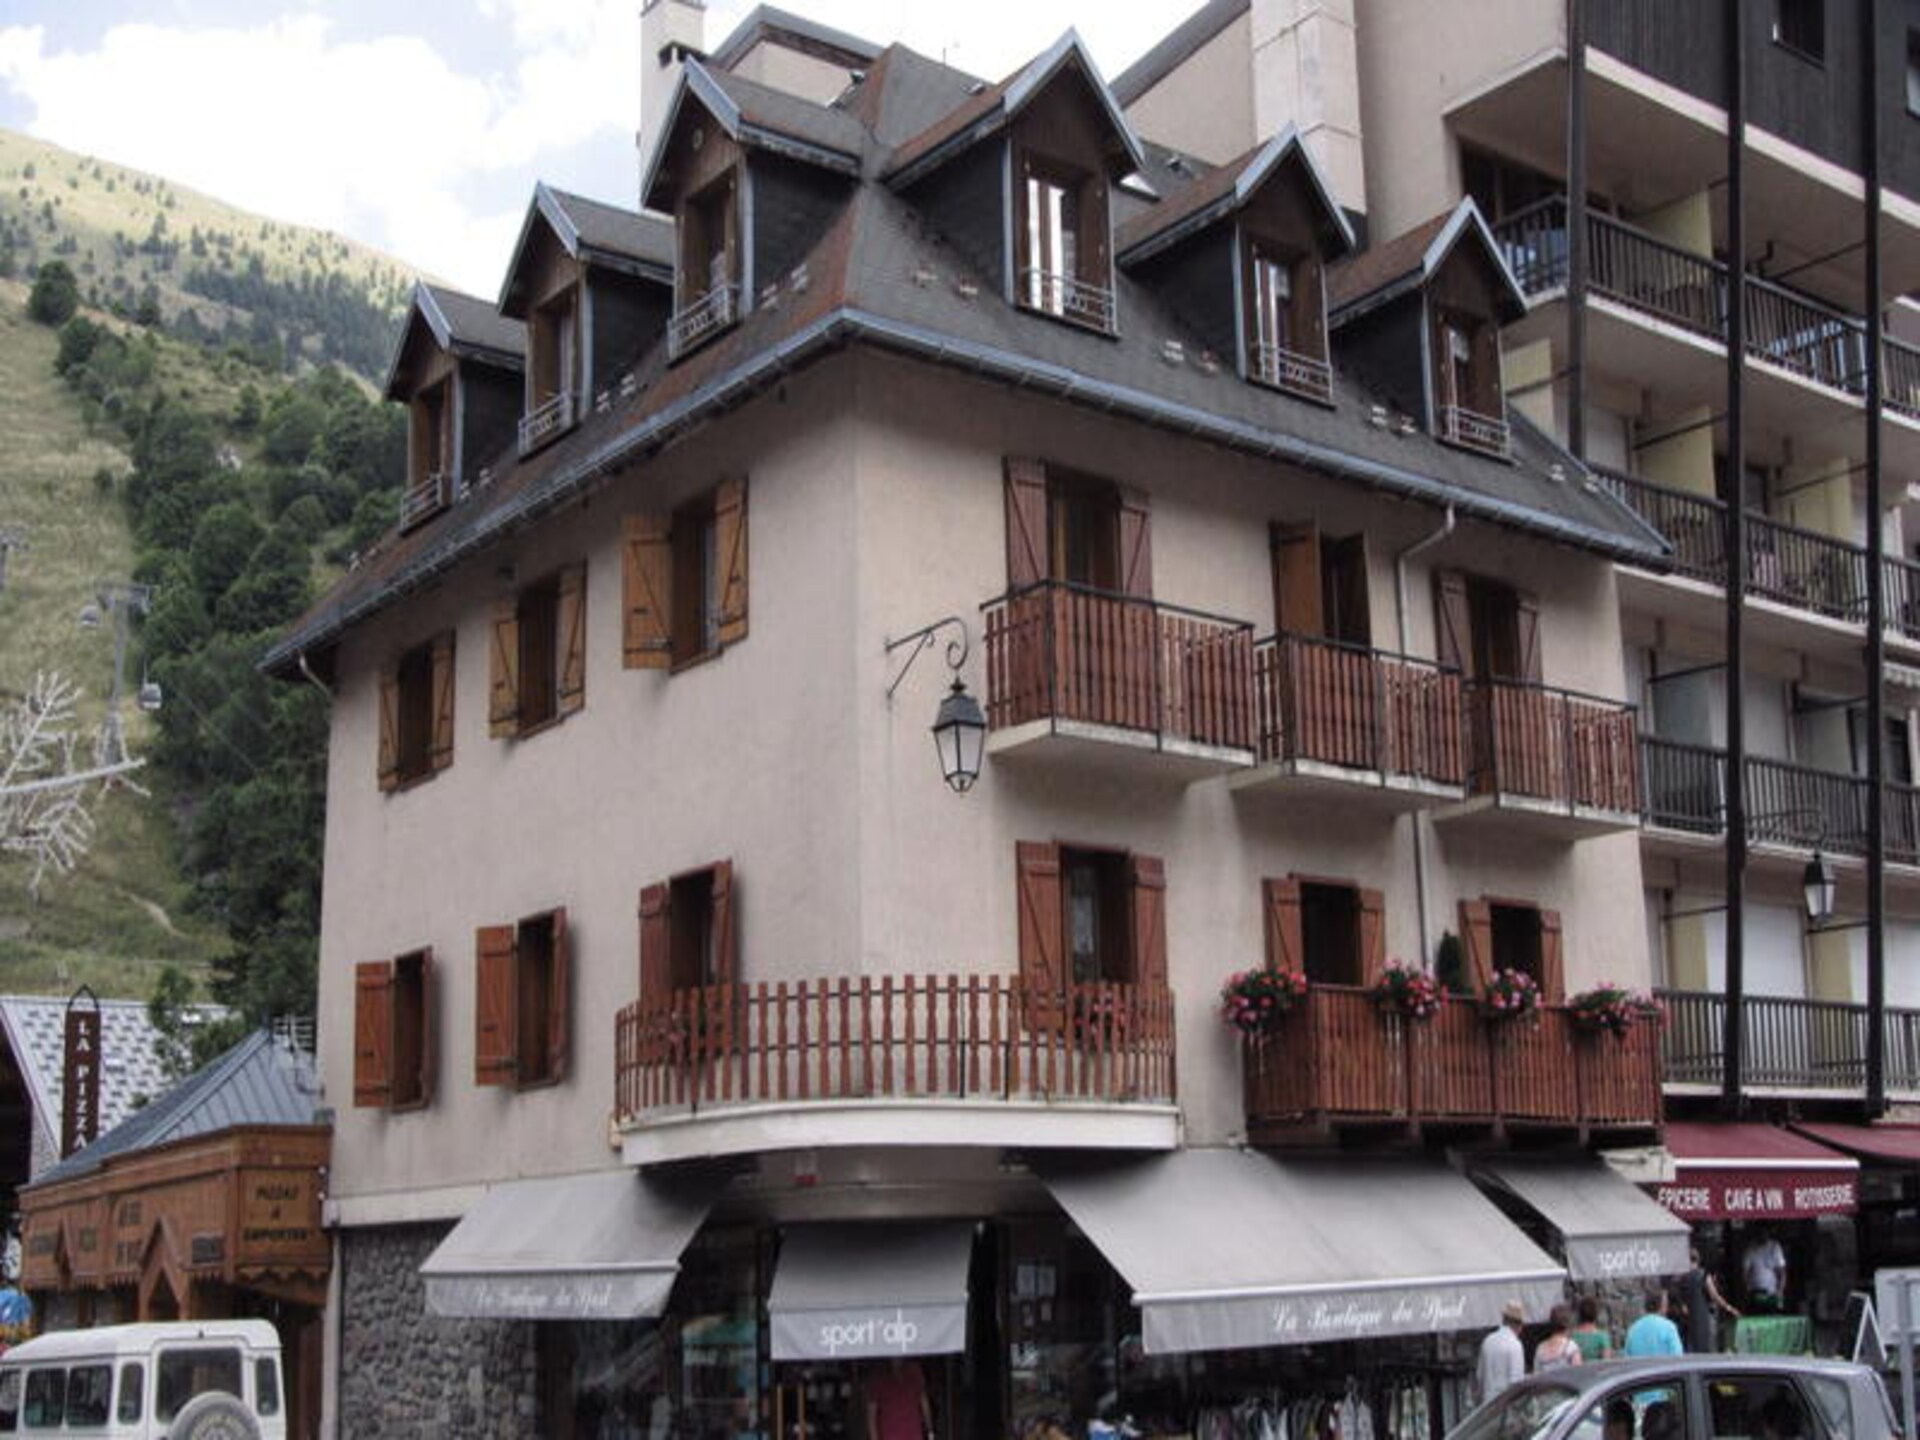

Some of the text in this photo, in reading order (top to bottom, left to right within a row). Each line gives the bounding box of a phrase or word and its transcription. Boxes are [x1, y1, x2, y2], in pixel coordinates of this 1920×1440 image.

[73, 1021, 91, 1149] LA PIZZA
[1724, 1187, 1754, 1210] CAVE
[1764, 1188, 1784, 1210] VIN
[1794, 1184, 1855, 1210] ROTISSERIE
